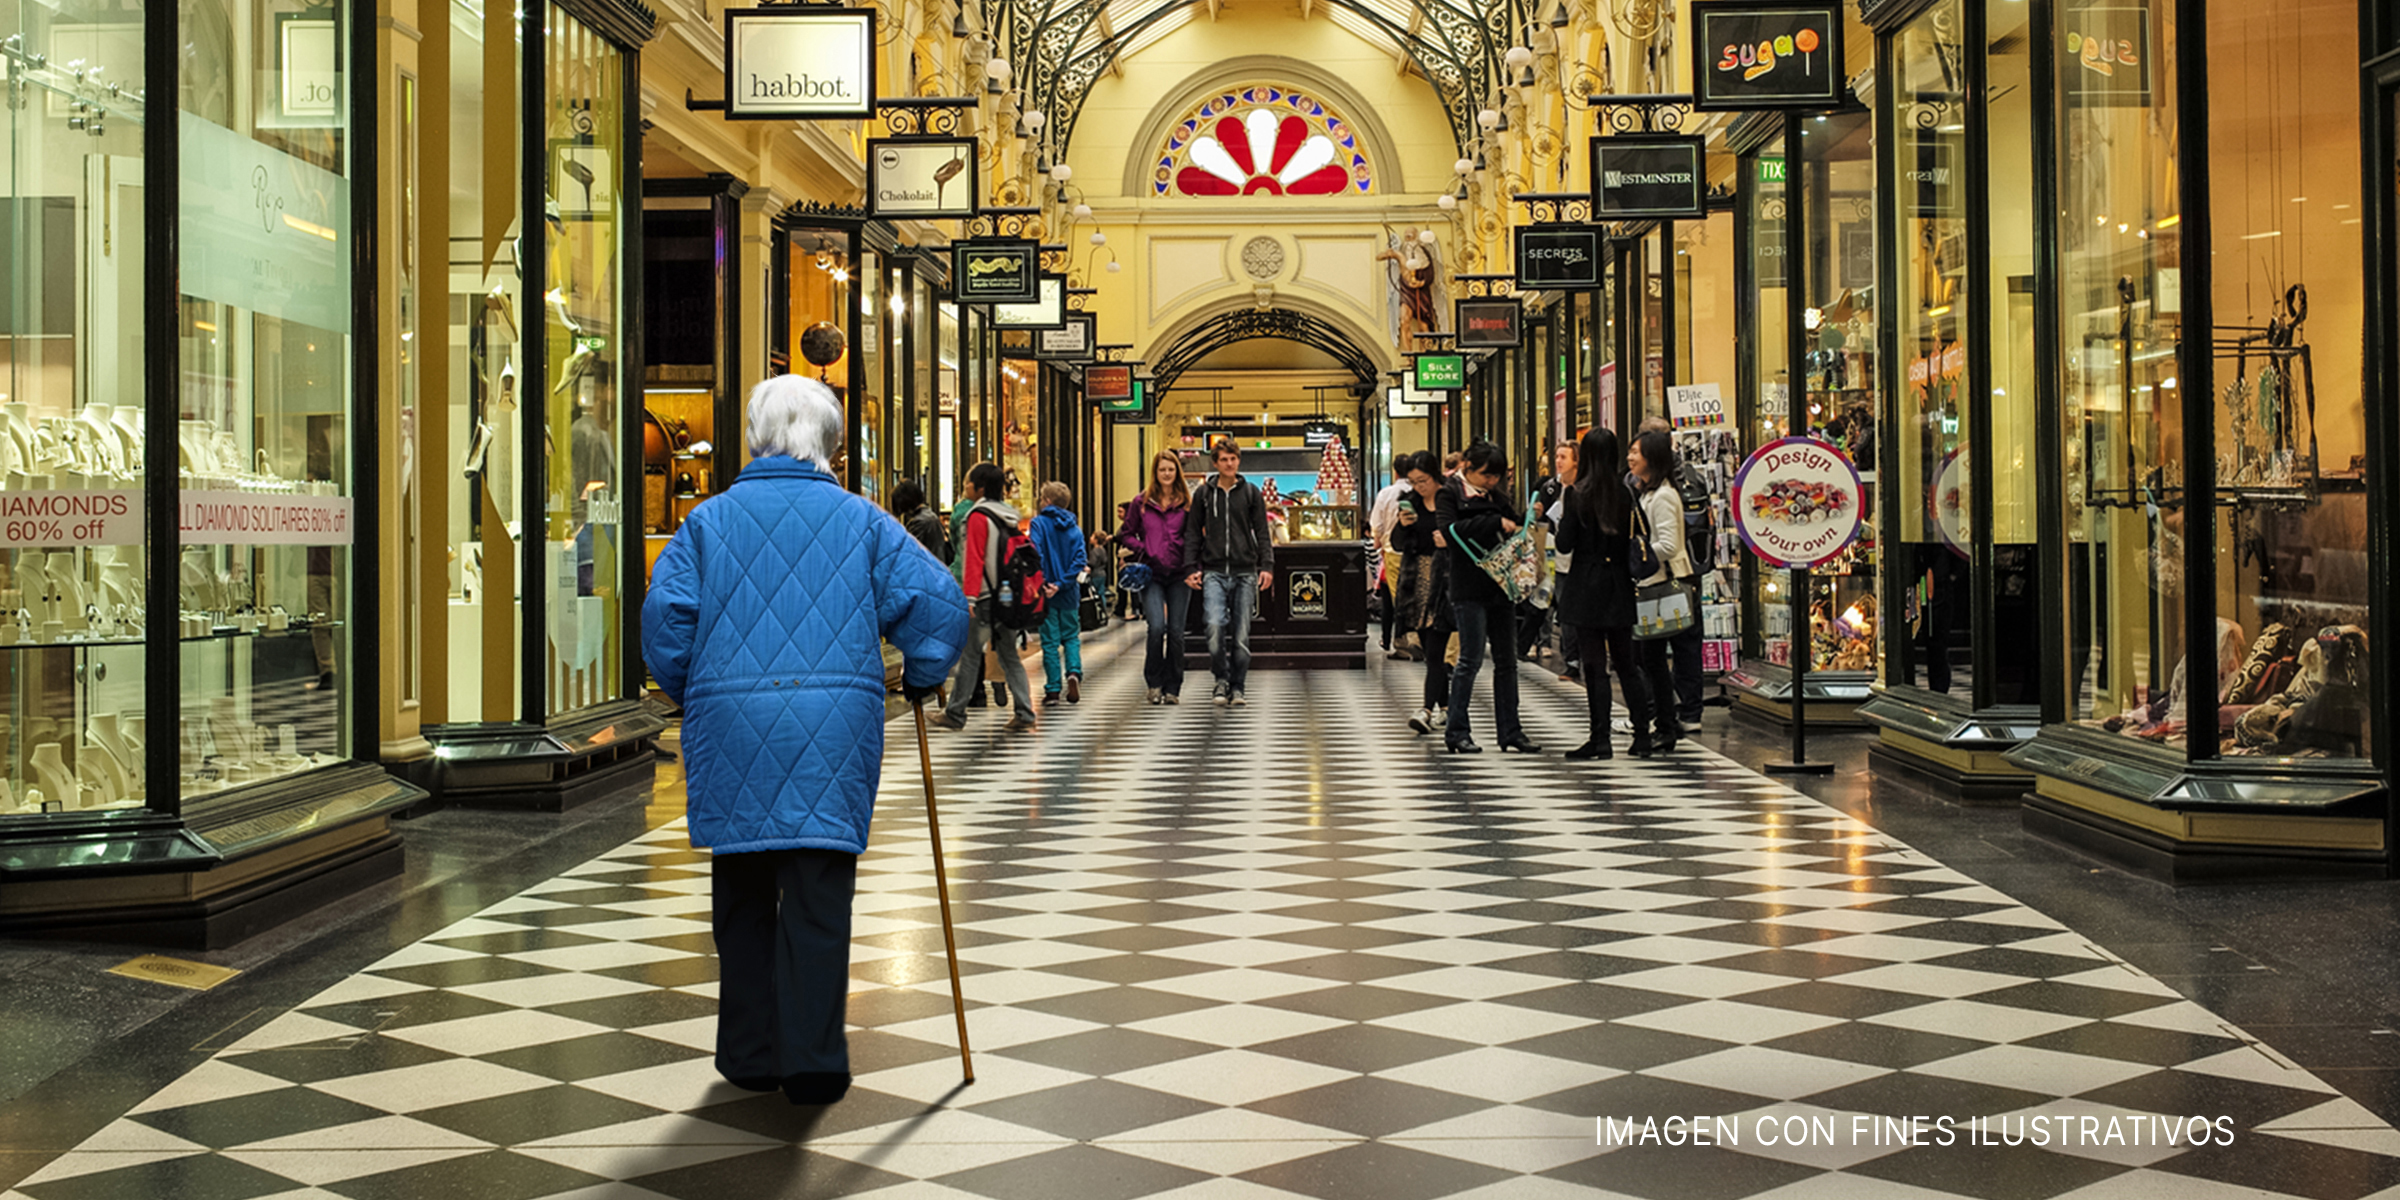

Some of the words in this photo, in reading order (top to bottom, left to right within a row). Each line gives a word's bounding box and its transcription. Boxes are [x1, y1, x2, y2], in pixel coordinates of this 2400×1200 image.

[750, 73, 851, 98] habbot.
[1604, 171, 1692, 188] WESTMINSTER
[1528, 248, 1583, 259] SECRETS
[1422, 371, 1459, 380] STORE
[1427, 362, 1454, 371] SILK
[1764, 448, 1833, 473] Design
[0, 495, 127, 516] IAMONDS
[196, 503, 250, 532] DIAMOND
[251, 507, 311, 533] SOLITAIRES
[311, 510, 332, 533] 60%
[333, 508, 346, 533] off
[6, 521, 63, 541] 60%
[72, 519, 105, 540] off
[1755, 527, 1800, 552] your
[1803, 527, 1838, 552] own
